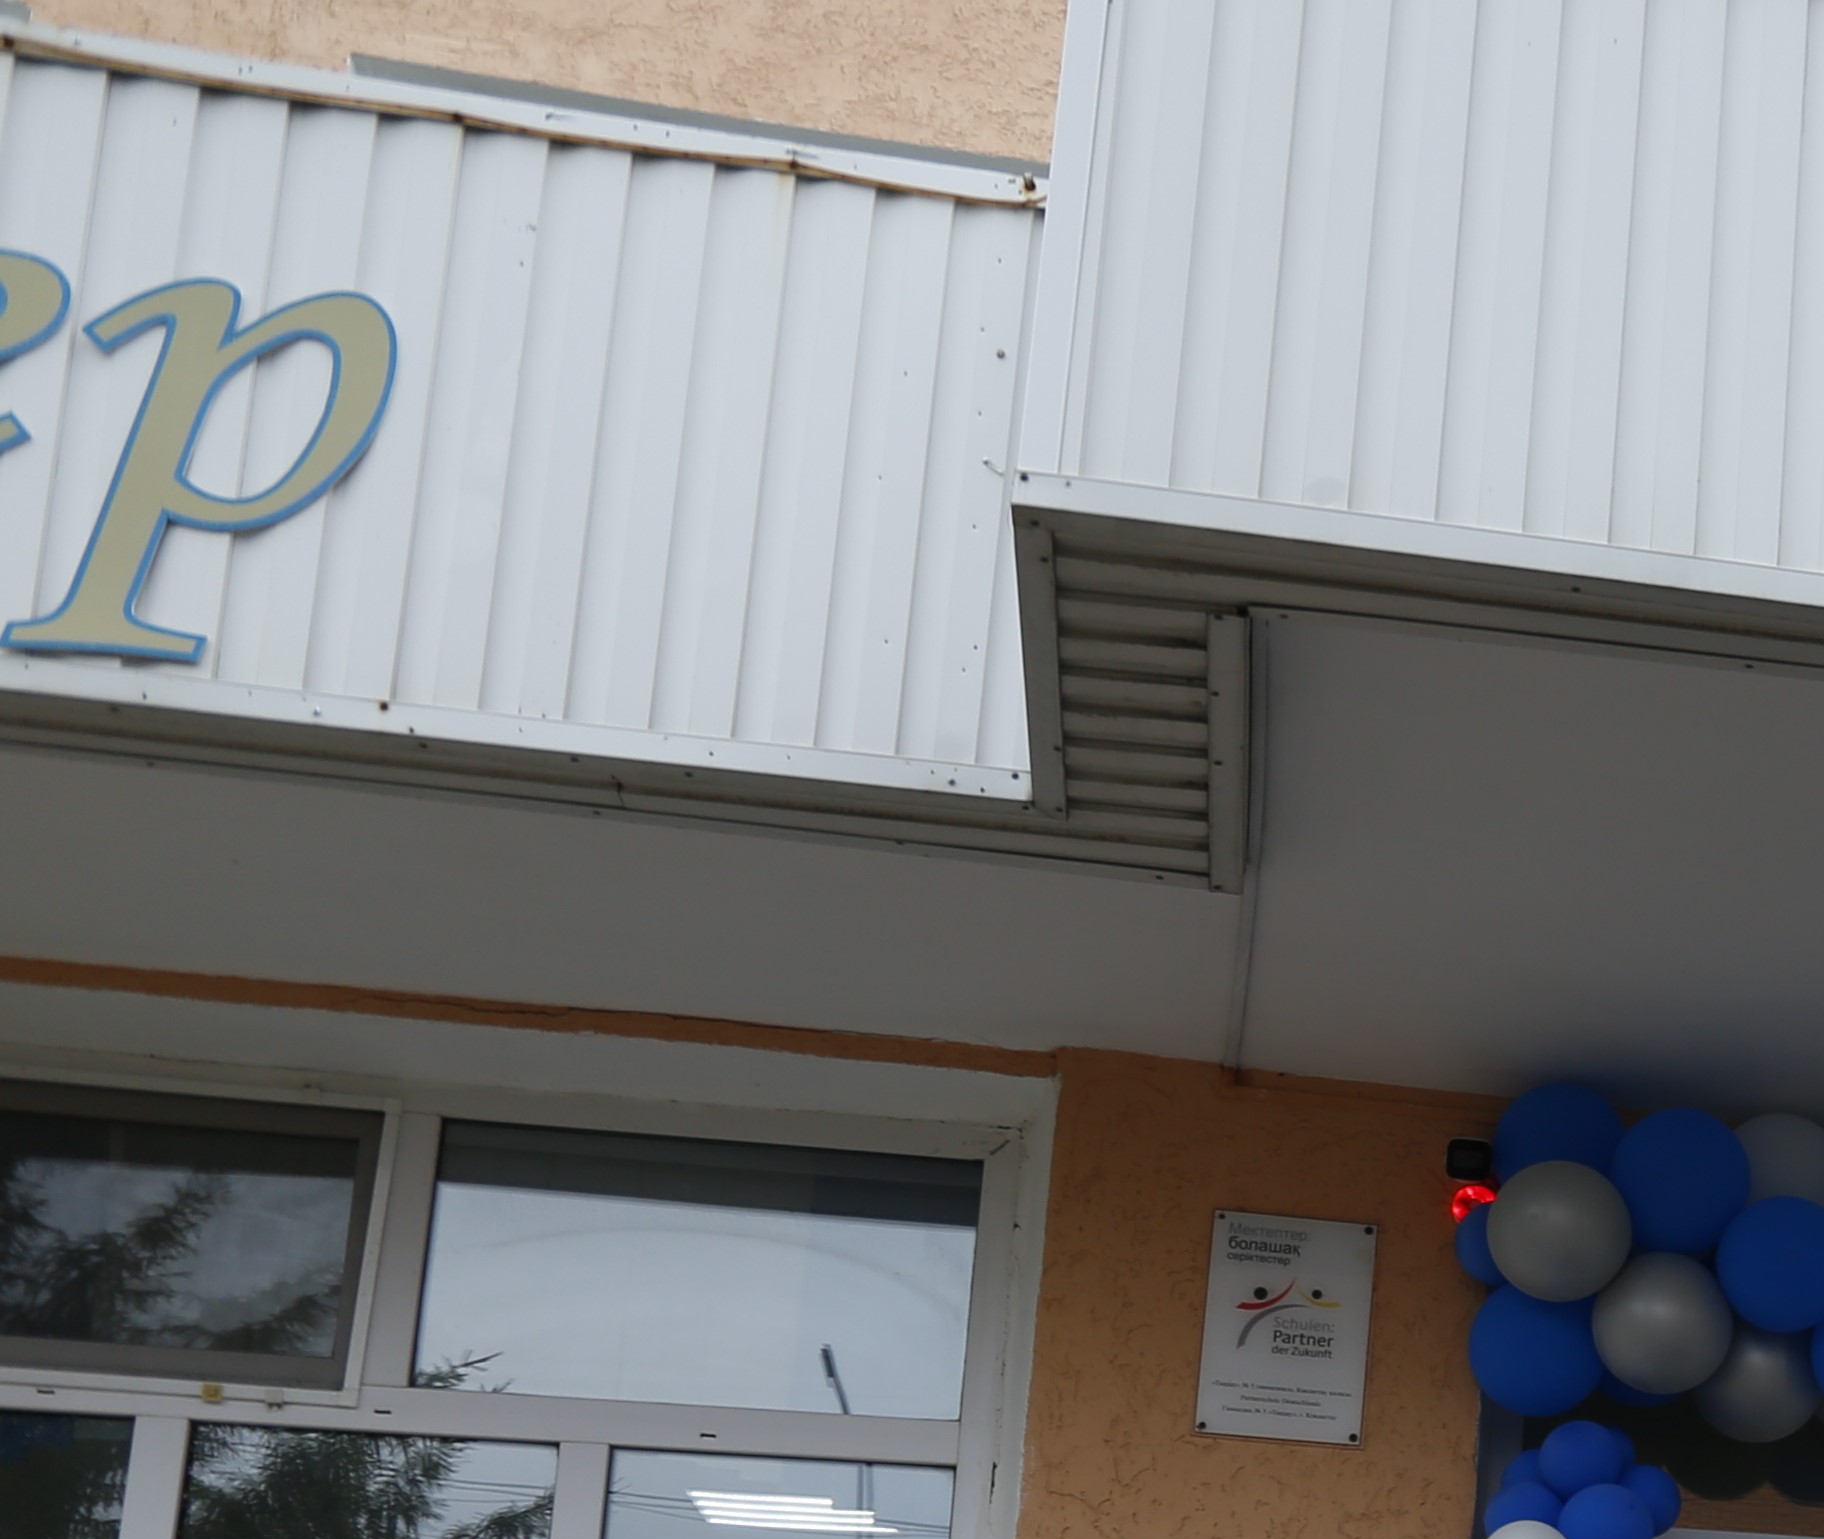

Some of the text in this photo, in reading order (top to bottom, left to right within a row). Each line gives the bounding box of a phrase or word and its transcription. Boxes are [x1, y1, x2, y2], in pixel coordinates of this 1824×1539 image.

[1228, 1236, 1301, 1257] болашақ
[1226, 1251, 1291, 1266] серіктестер
[1273, 1316, 1335, 1332] Schulen:
[1273, 1330, 1334, 1348] Partner
[1272, 1345, 1332, 1359] der Zukunft
